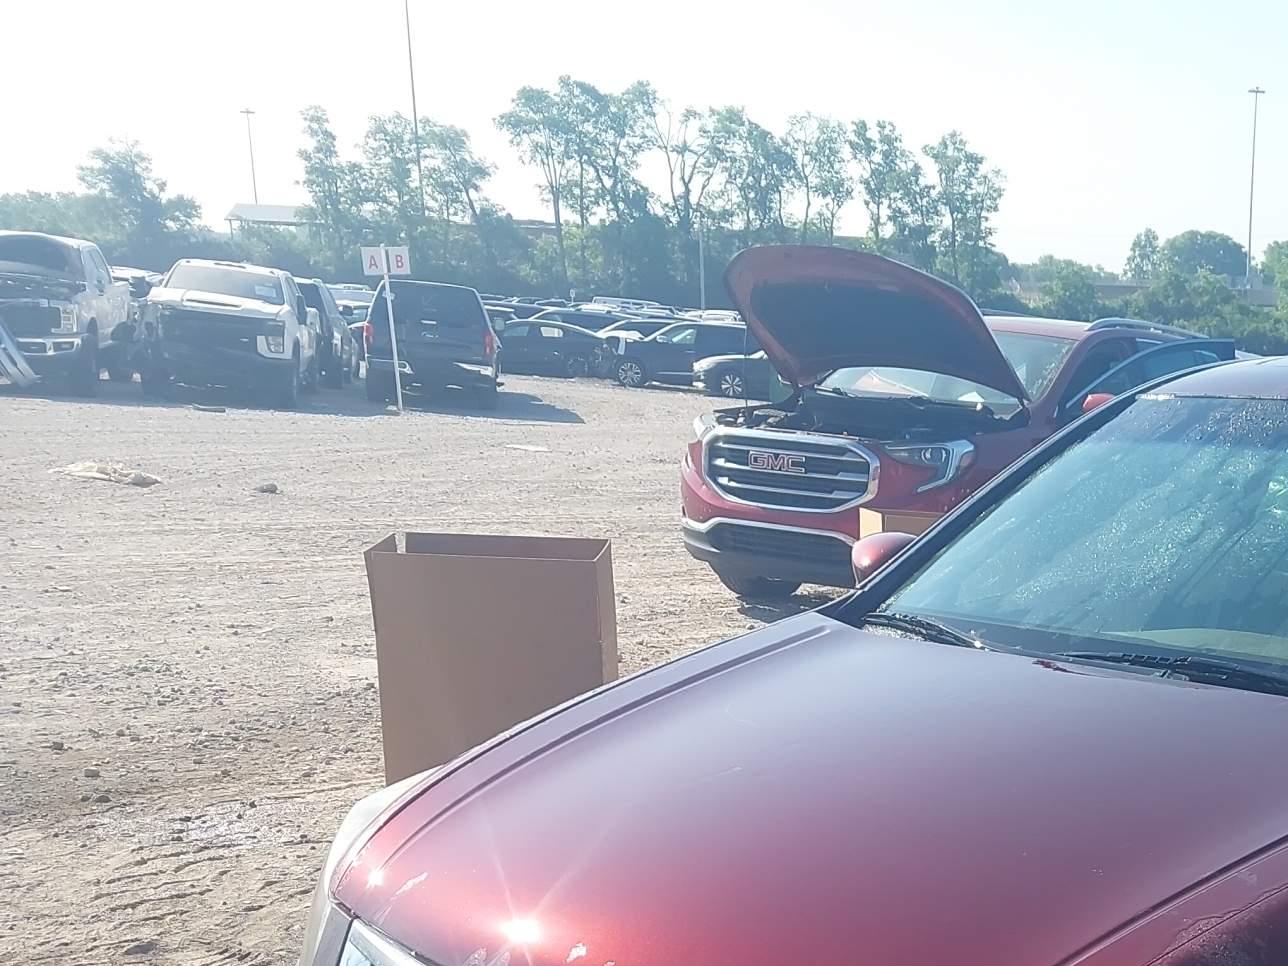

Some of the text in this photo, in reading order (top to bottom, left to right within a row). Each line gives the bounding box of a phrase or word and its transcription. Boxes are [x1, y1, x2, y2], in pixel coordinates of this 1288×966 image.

[368, 255, 379, 270] A
[395, 254, 404, 269] B
[747, 450, 807, 474] GMC
